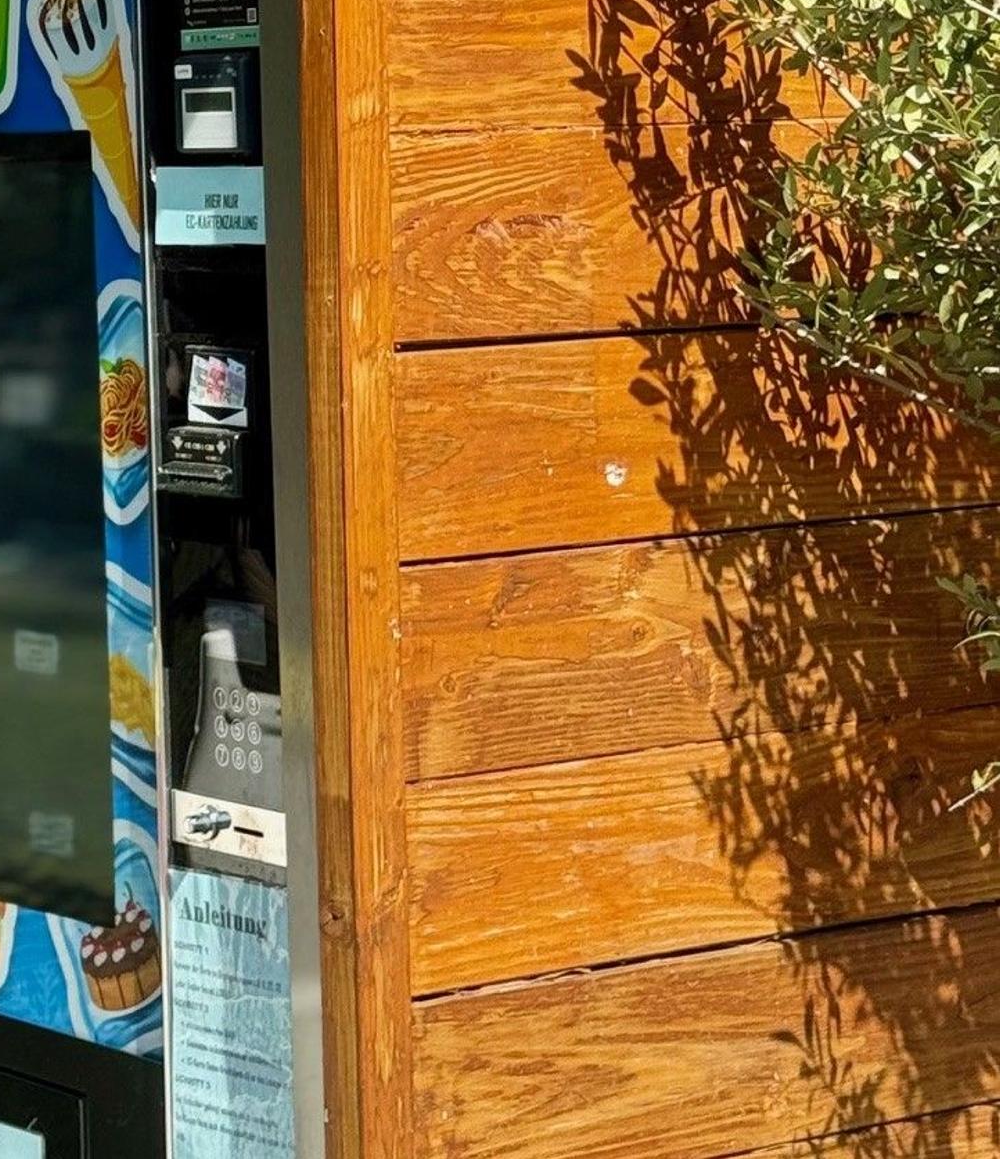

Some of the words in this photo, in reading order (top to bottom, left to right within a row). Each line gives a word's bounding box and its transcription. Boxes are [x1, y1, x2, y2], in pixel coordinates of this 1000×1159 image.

[204, 193, 222, 210] HIER
[222, 193, 239, 210] NUR
[179, 897, 267, 942] Anleitung
